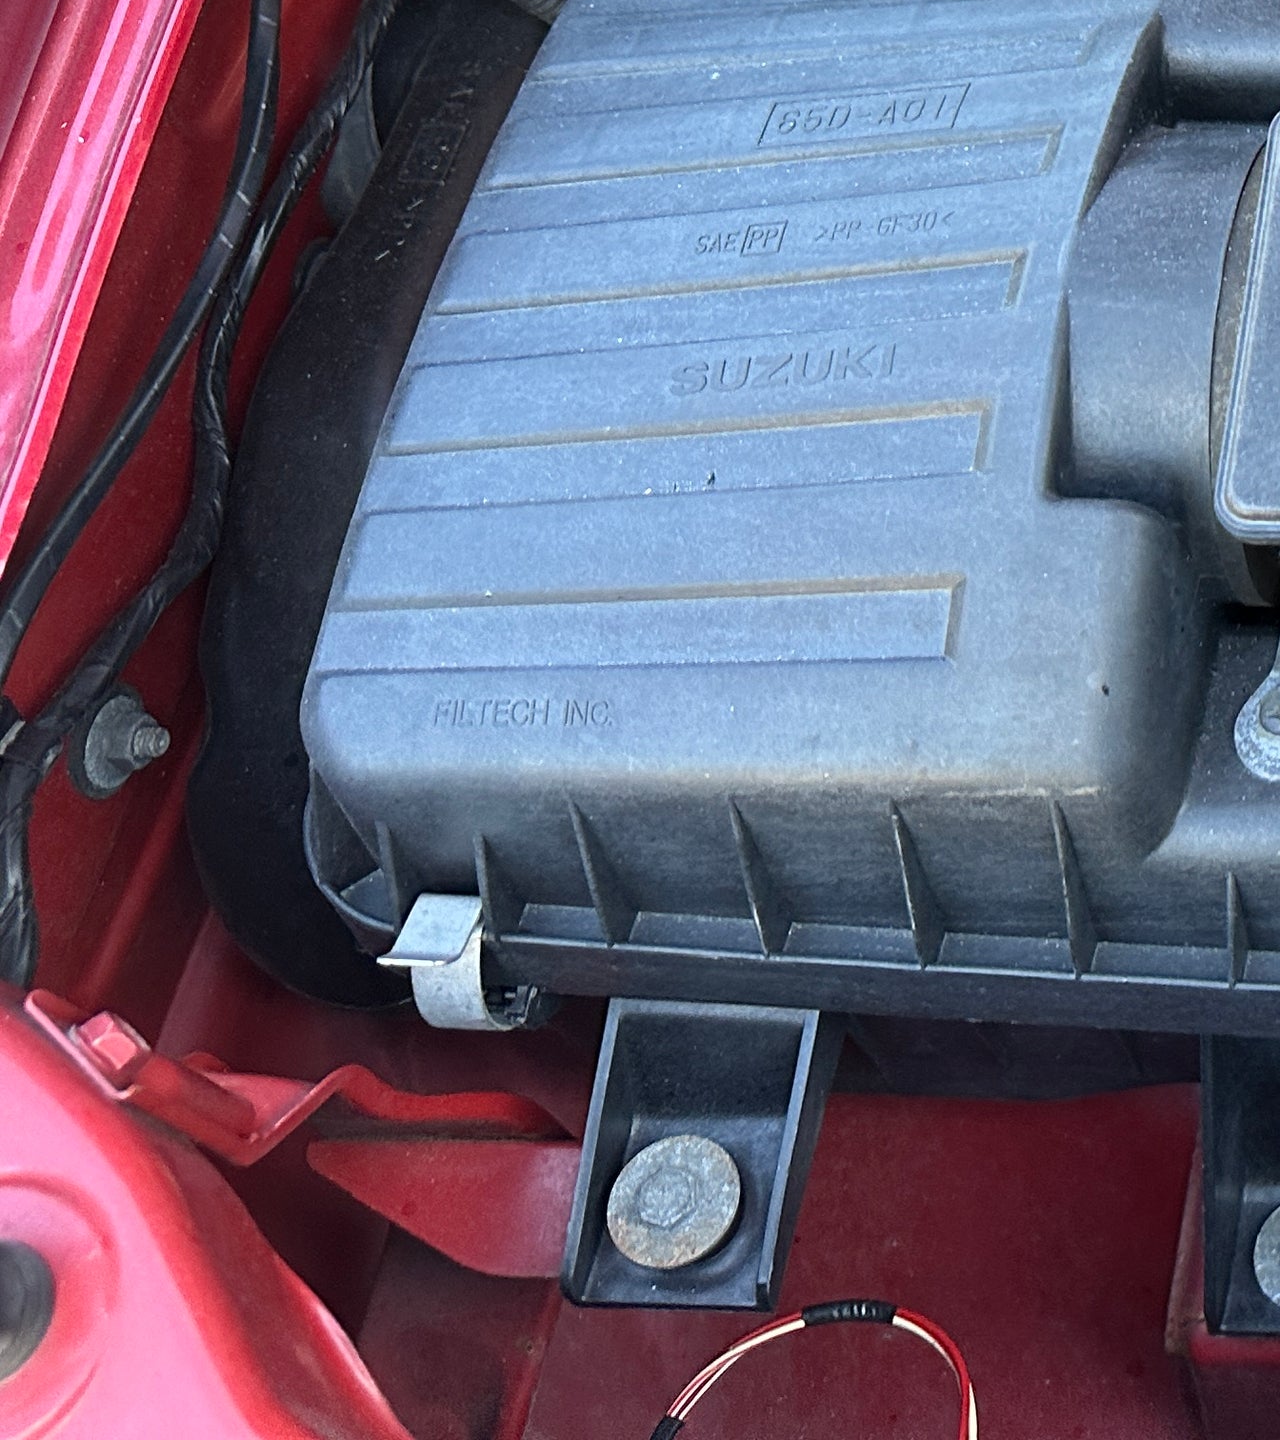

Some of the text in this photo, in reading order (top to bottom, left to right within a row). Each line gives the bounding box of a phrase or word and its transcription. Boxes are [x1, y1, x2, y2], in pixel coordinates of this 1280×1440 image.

[694, 229, 741, 256] SAE
[747, 225, 781, 250] PP
[670, 342, 899, 396] SUZUKI
[433, 698, 613, 729] FILTECH INC.
